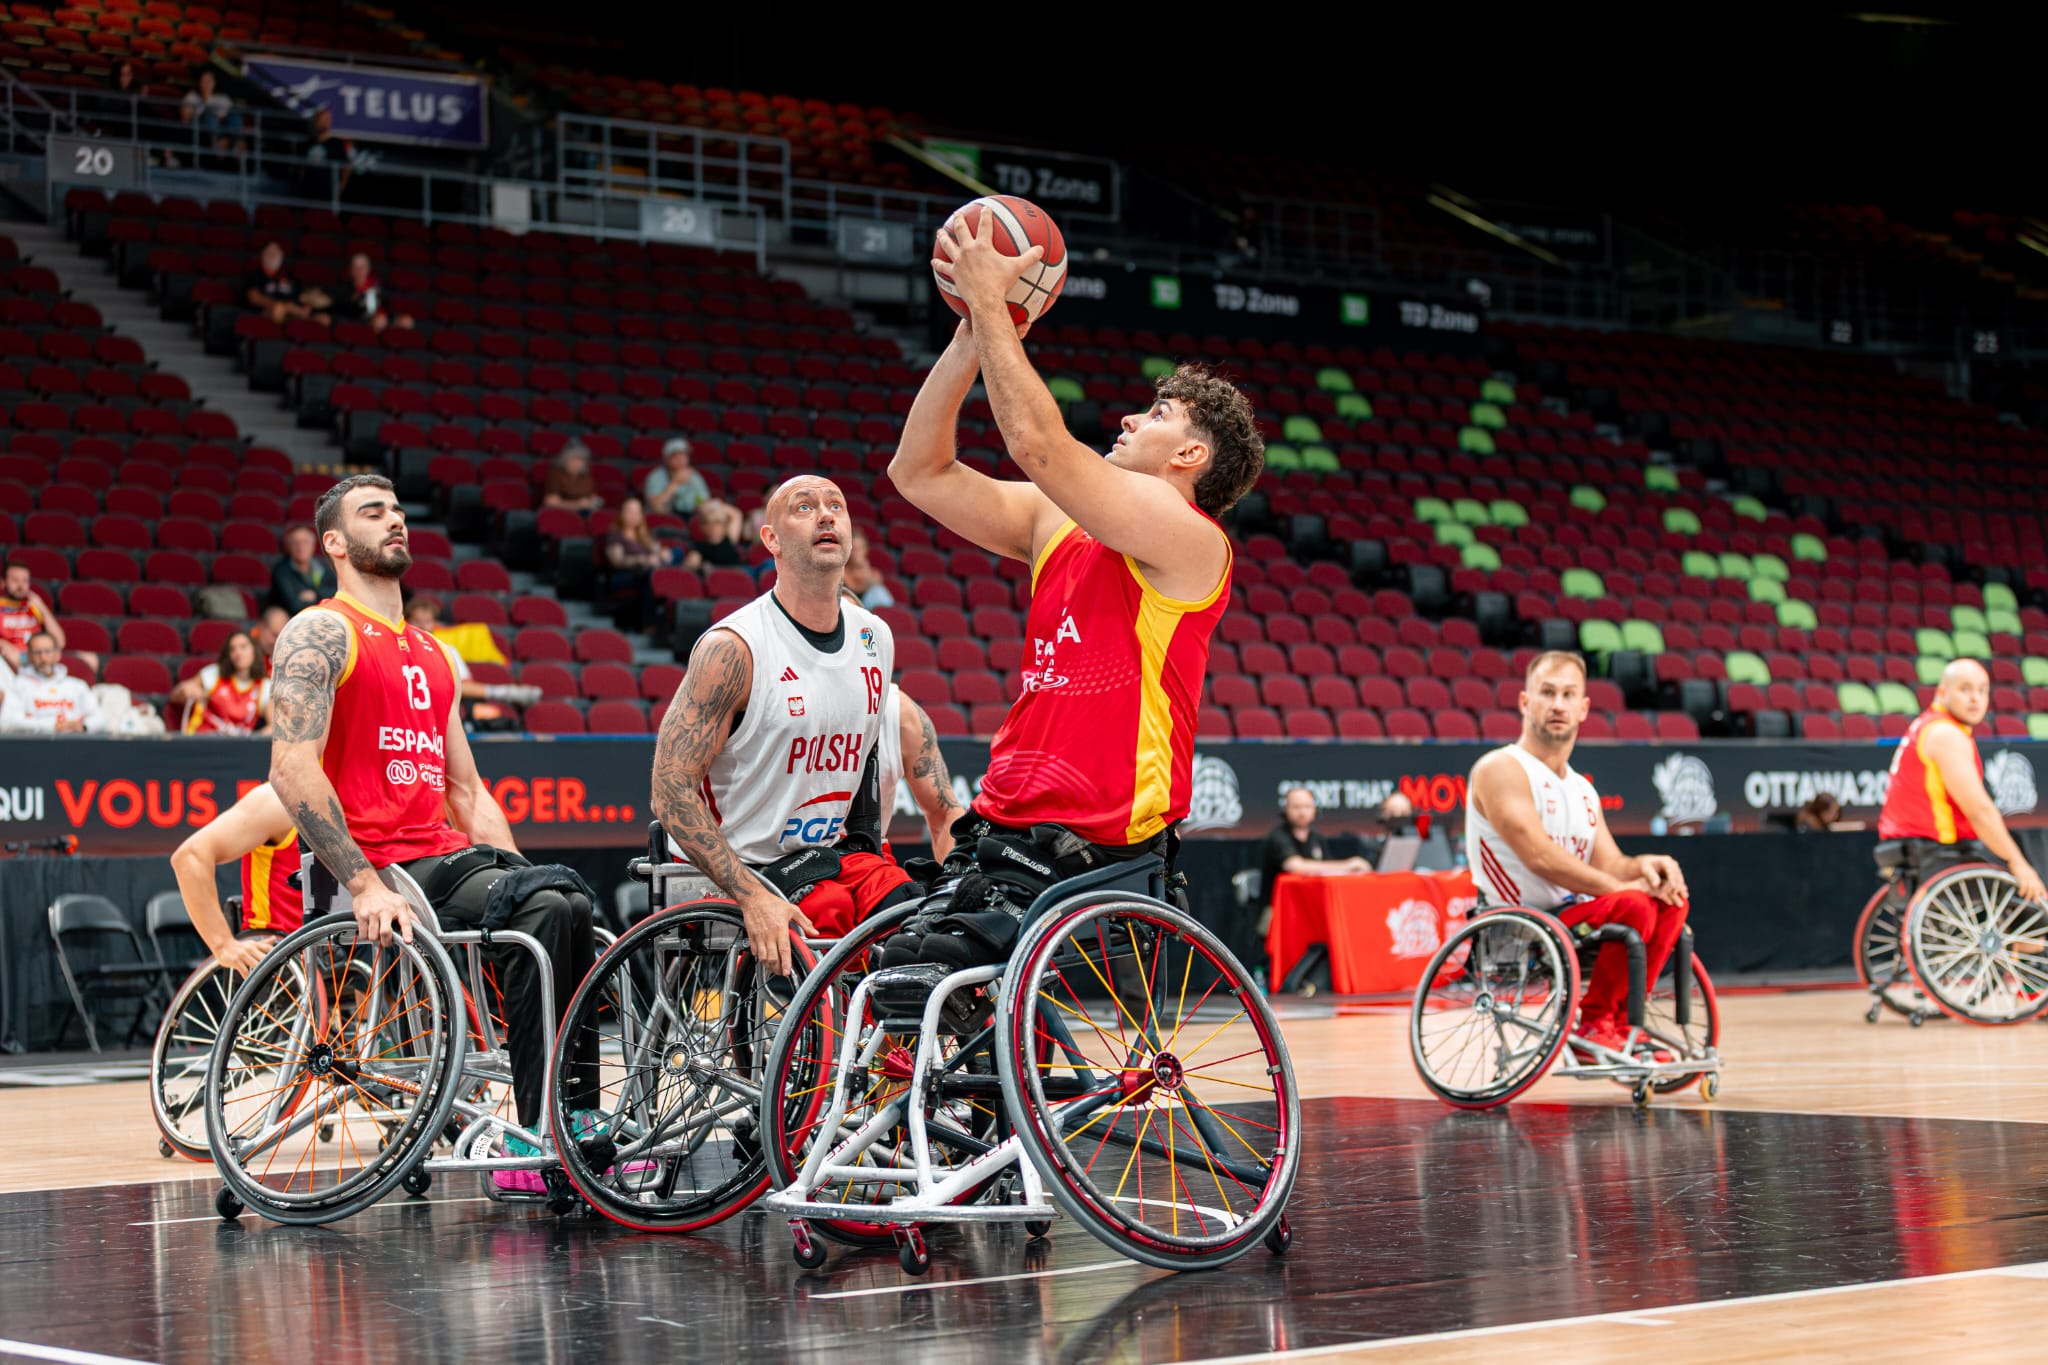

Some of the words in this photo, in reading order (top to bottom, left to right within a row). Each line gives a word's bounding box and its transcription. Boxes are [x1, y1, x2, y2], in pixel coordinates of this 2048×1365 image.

[338, 85, 463, 127] TELUS
[75, 145, 115, 176] 20
[994, 162, 1033, 195] TD
[1036, 168, 1101, 201] Zone
[664, 206, 696, 233] 20
[1214, 284, 1246, 310] TD
[1246, 287, 1300, 317] Zone
[1399, 301, 1429, 328] TD
[1429, 304, 1479, 334] Zone
[402, 665, 432, 710] 13
[860, 666, 883, 715] 19
[54, 778, 219, 829] VOUS
[480, 776, 635, 824] GER...
[1343, 780, 1394, 809] THAT
[778, 817, 846, 844] PGE
